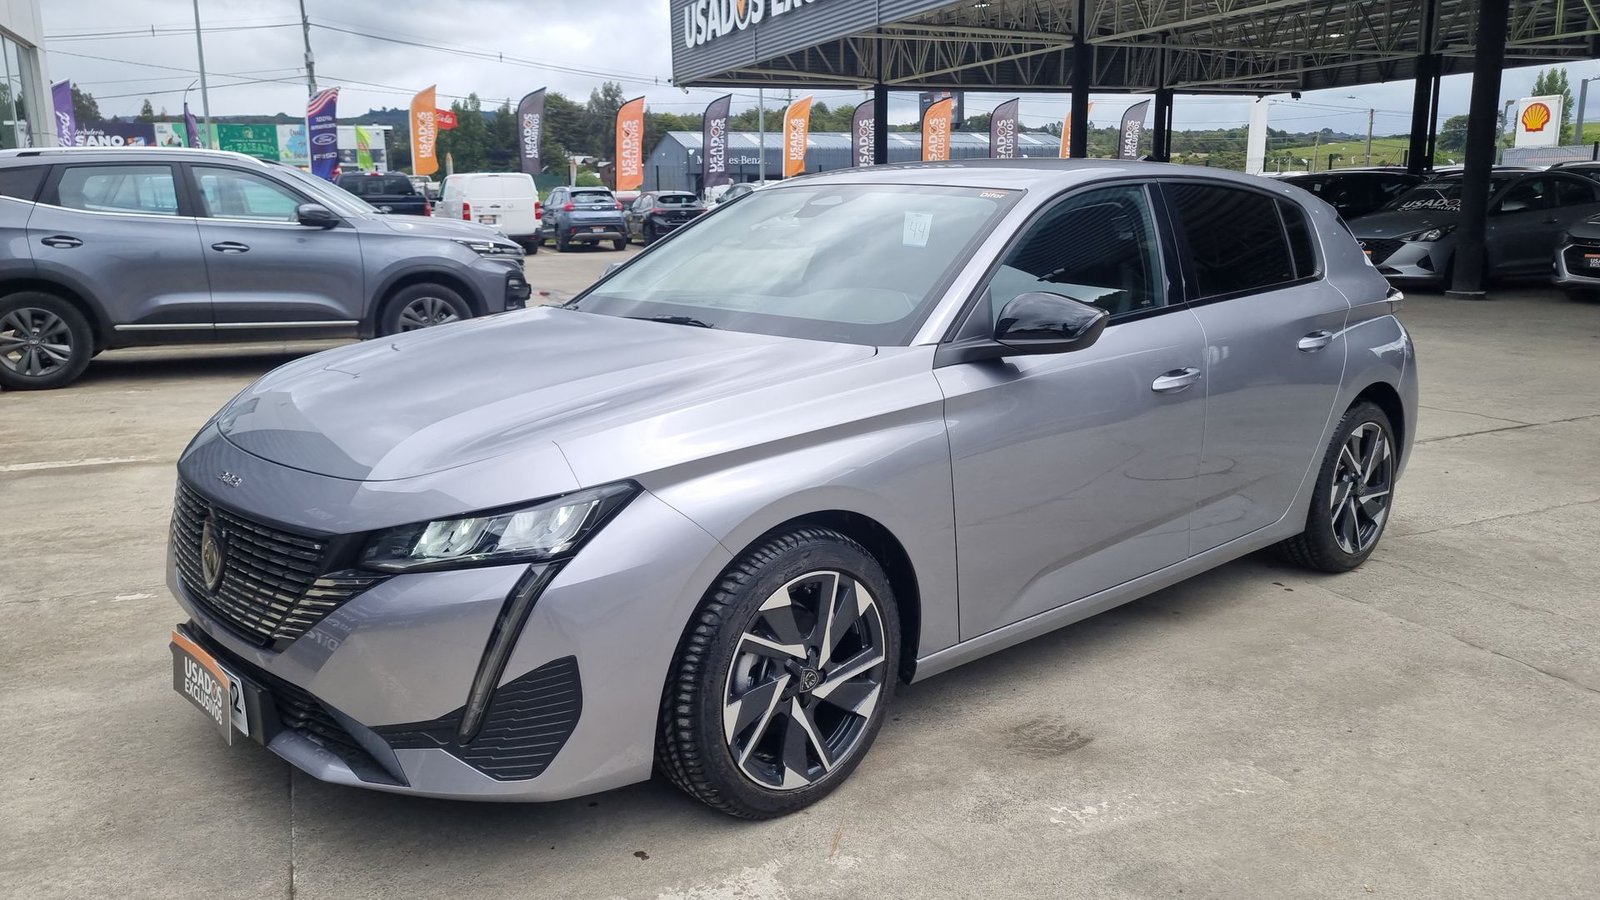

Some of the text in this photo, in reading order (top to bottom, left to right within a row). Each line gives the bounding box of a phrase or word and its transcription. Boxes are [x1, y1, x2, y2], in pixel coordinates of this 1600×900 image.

[684, 0, 765, 48] USADOS
[523, 113, 534, 158] USADOS
[621, 120, 633, 176] USADOS
[630, 120, 639, 176] EXCLUSIVOS
[709, 119, 721, 173] USADOS
[790, 118, 799, 160] USADOS
[797, 118, 805, 160] EXCLUSIVOS
[928, 118, 939, 161] SADOS
[1124, 120, 1135, 156] USADOS
[1130, 121, 1140, 157] EXCLUSIVOS
[184, 656, 223, 708] USADOS
[184, 677, 223, 726] EXCLUSIVOS
